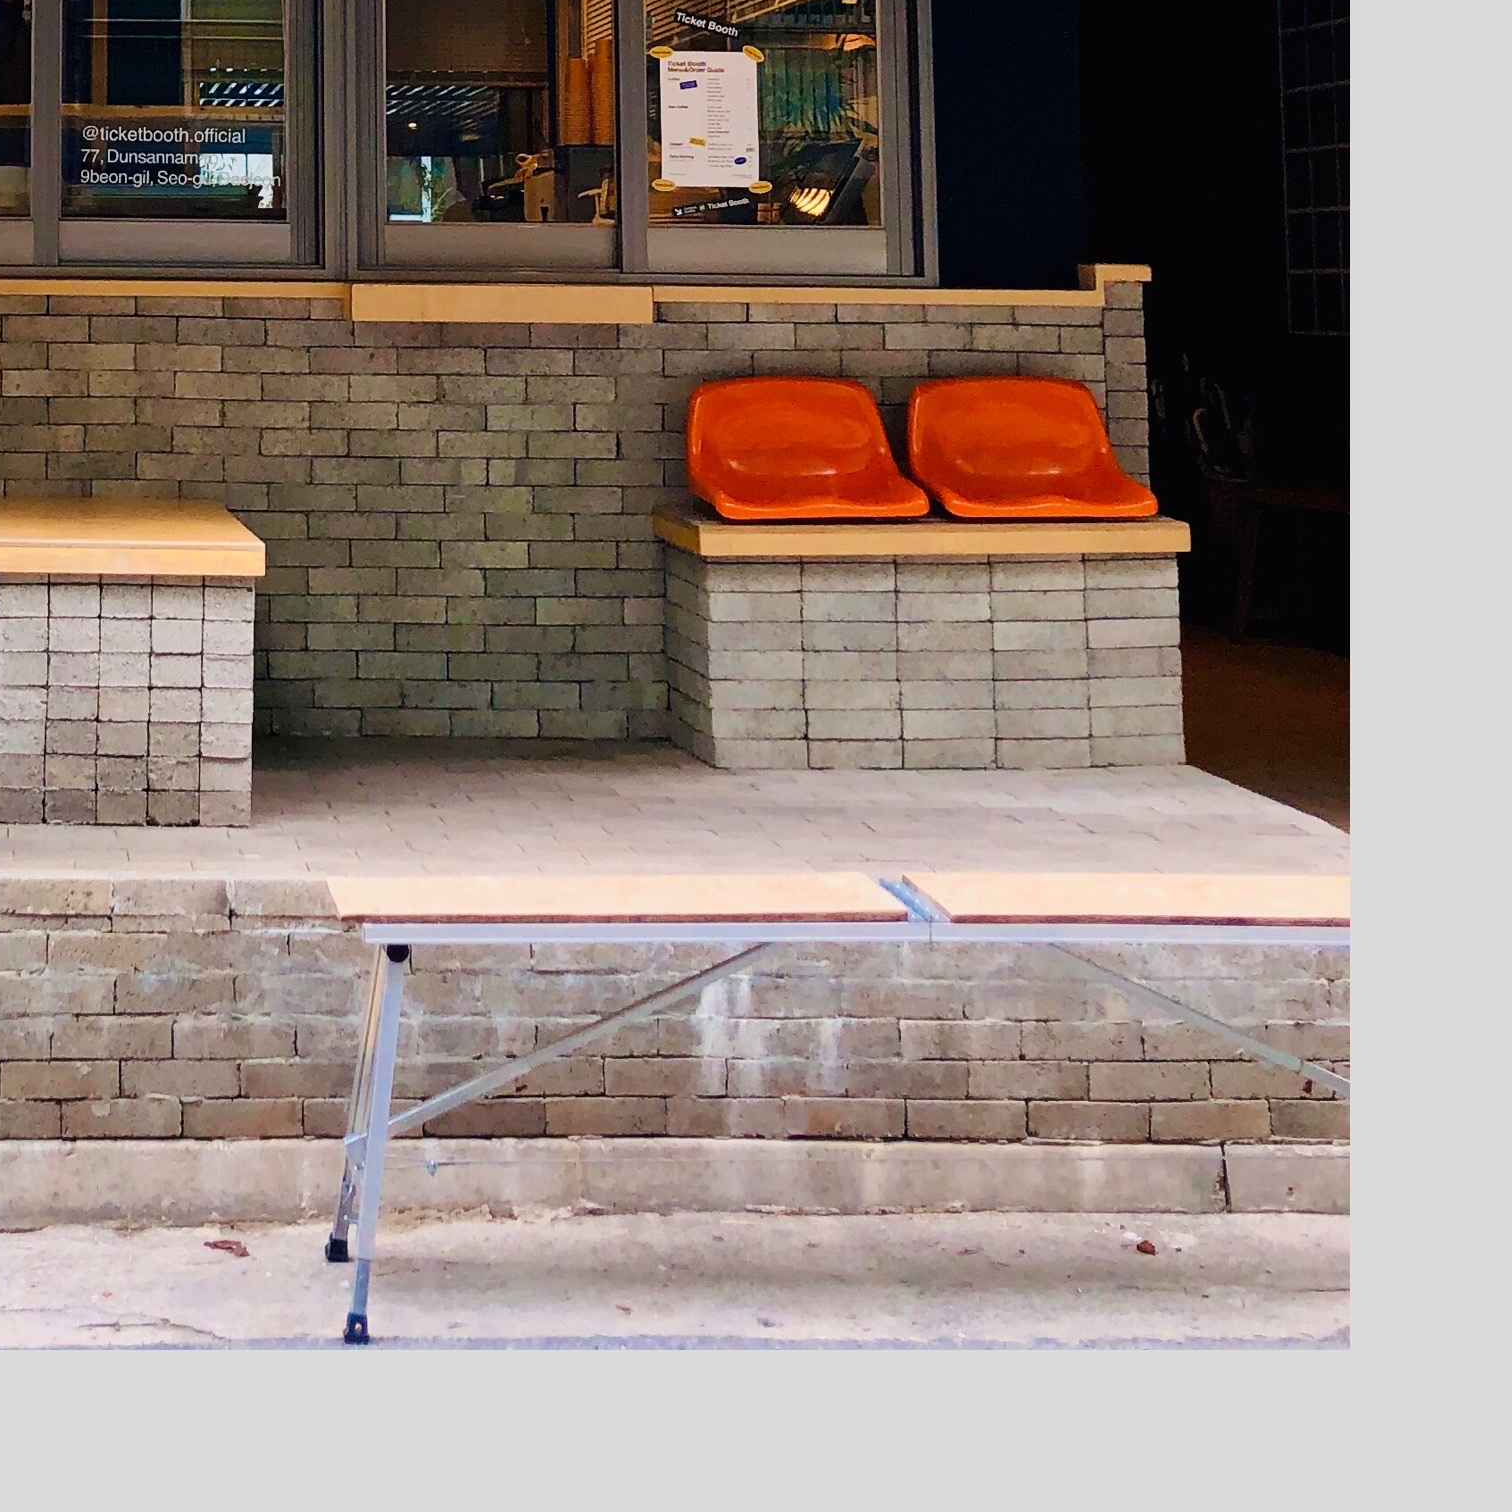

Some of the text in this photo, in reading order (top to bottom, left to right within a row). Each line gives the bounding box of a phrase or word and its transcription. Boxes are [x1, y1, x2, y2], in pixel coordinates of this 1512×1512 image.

[676, 11, 738, 37] Ticket Booth
[82, 125, 246, 144] @ticketbooth.official
[80, 148, 104, 165] 77,
[80, 169, 154, 188] 9beon-gil,
